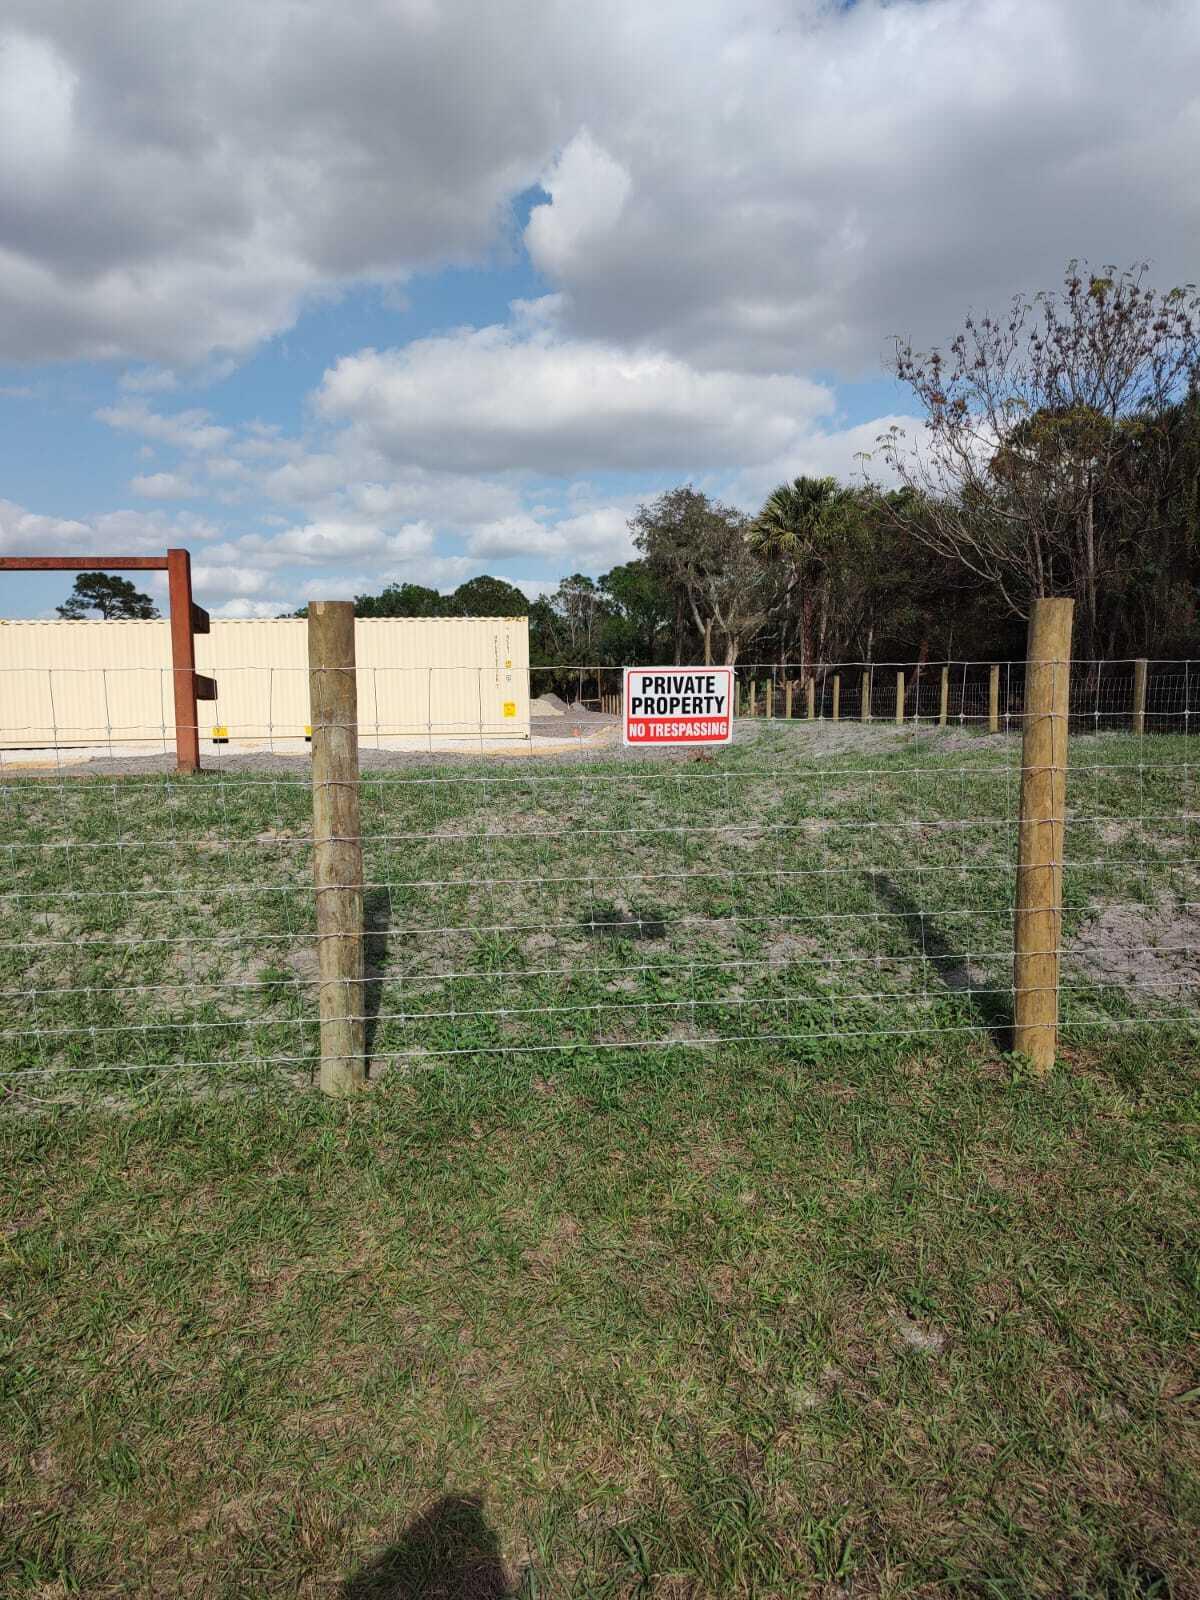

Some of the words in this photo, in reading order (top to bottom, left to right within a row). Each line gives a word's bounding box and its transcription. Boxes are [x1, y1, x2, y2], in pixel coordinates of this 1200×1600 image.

[642, 676, 716, 694] PRIVATE
[632, 696, 725, 715] PROPERTY
[629, 723, 645, 737] NO
[649, 722, 727, 737] TRESPASSING
